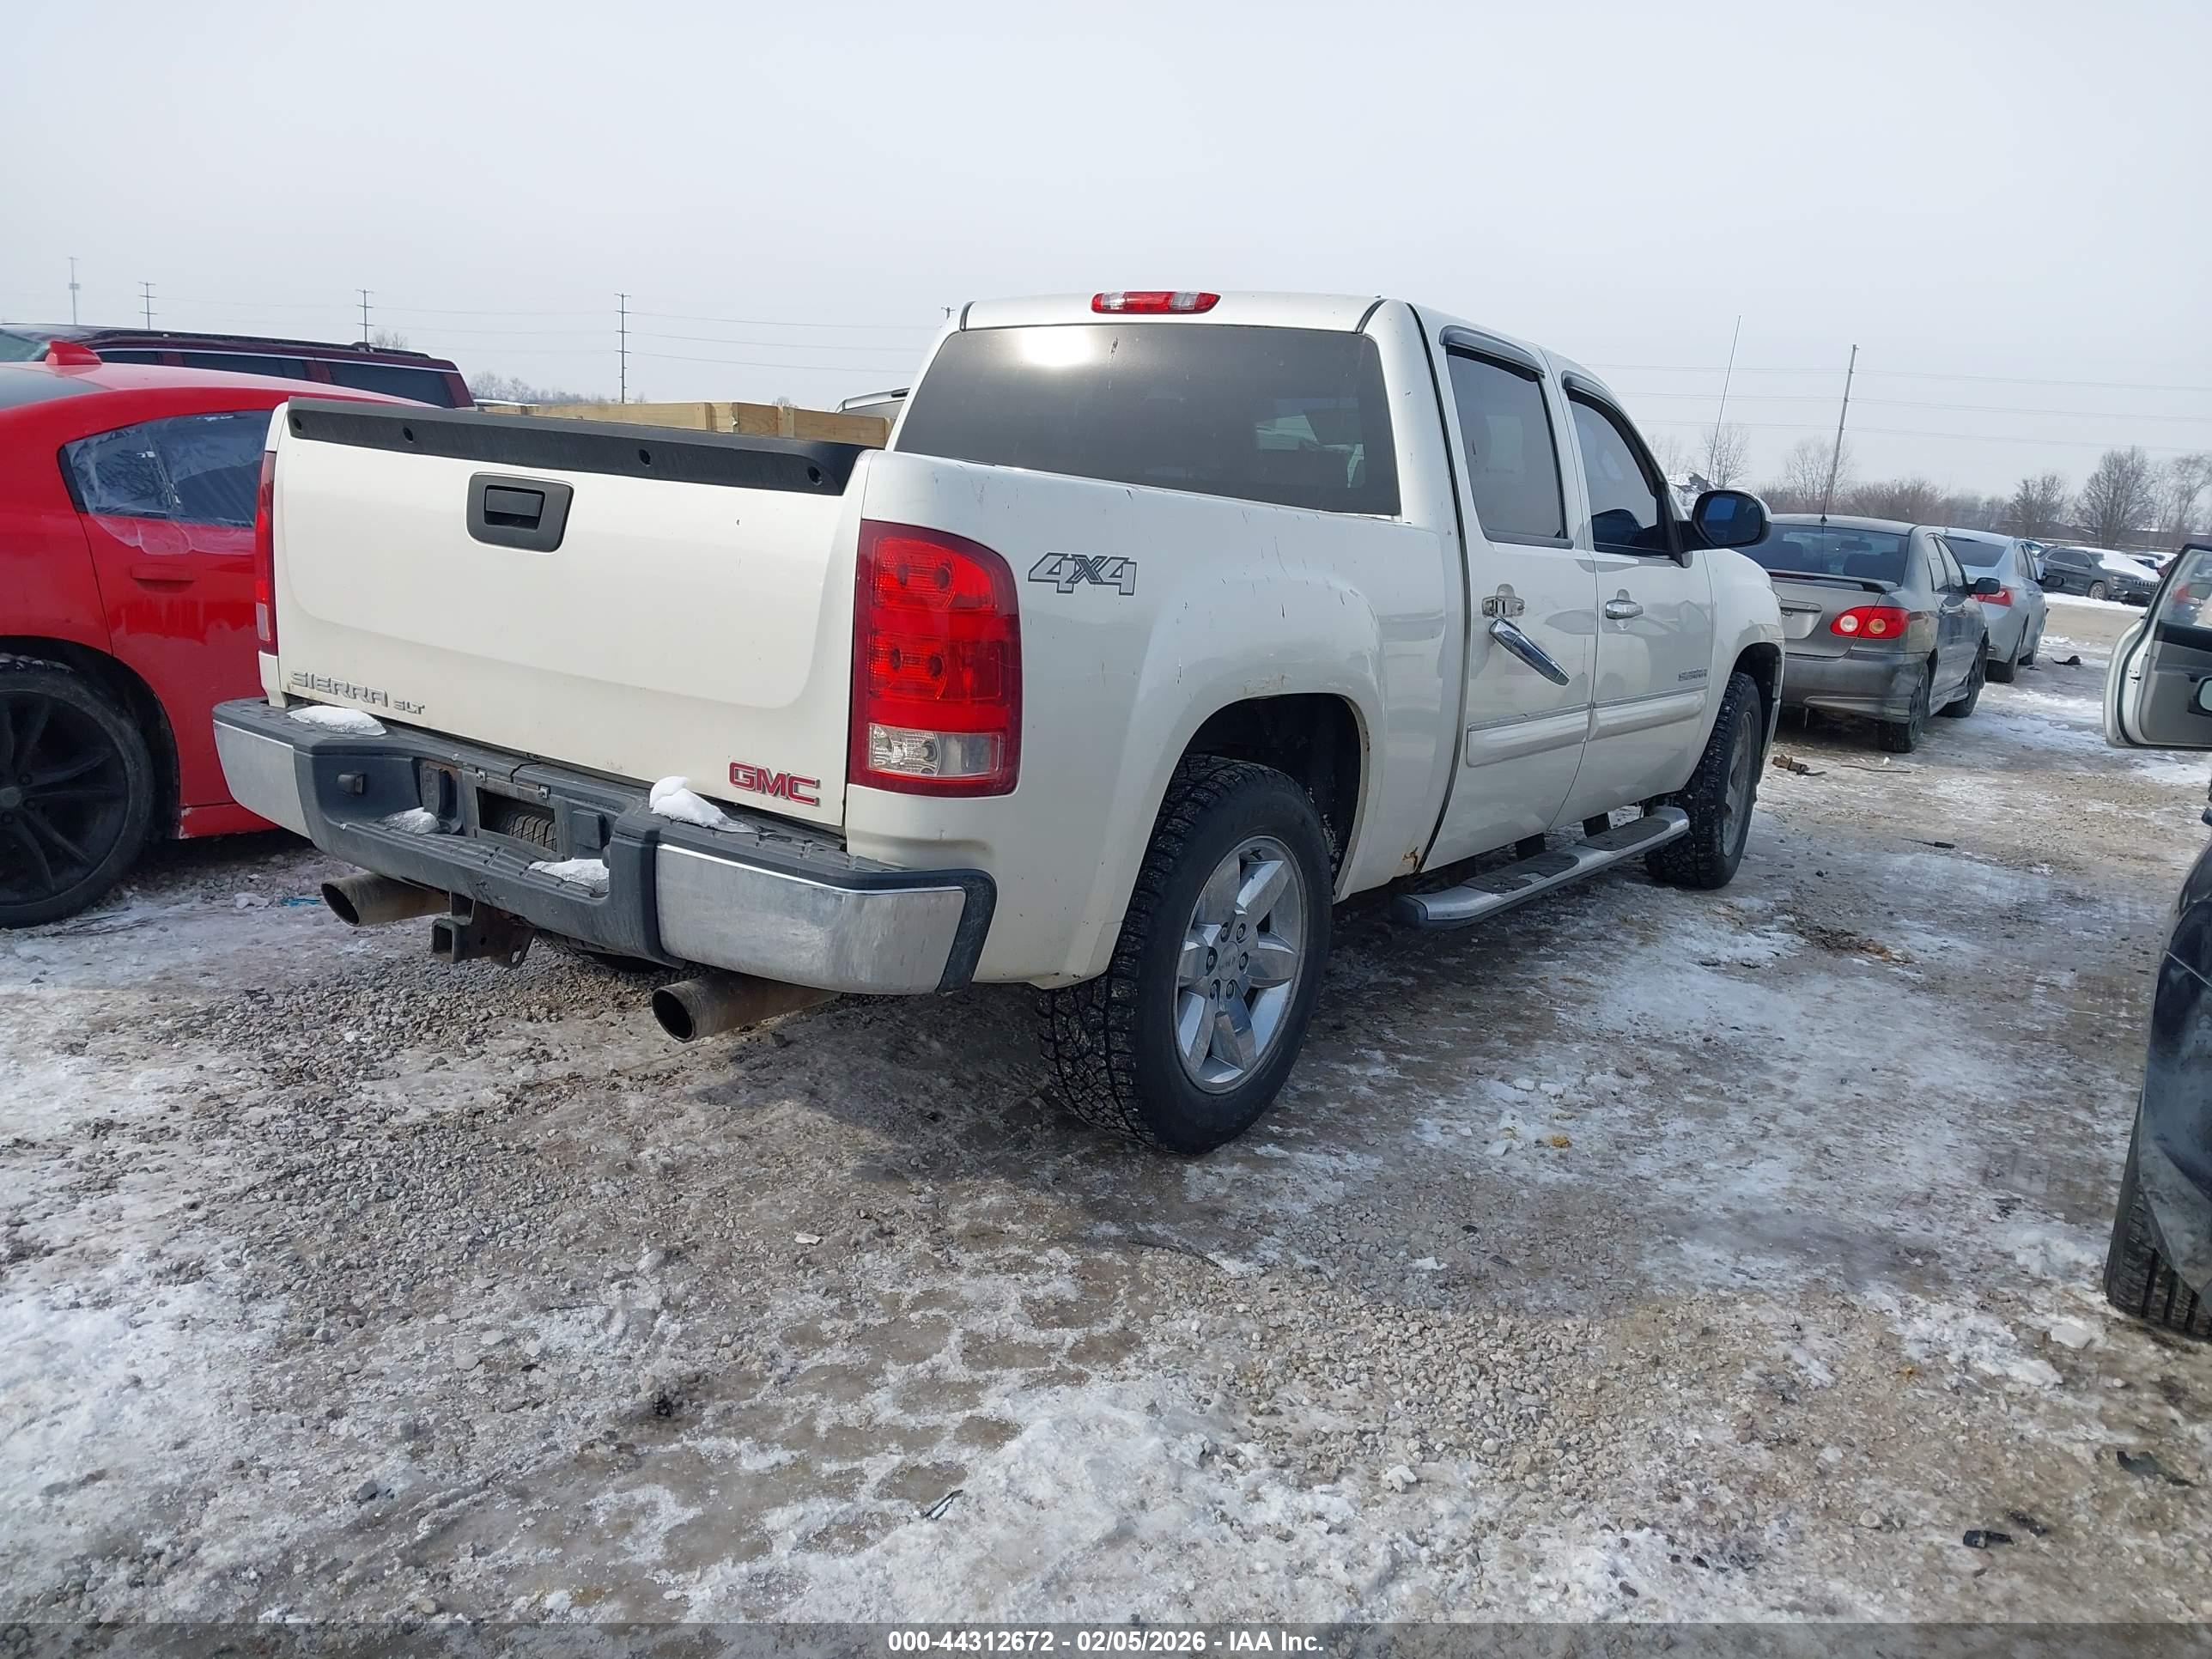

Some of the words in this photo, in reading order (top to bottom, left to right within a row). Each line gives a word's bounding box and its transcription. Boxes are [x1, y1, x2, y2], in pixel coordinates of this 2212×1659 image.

[290, 671, 388, 708] SIERRA
[393, 700, 425, 714] SLT
[728, 761, 820, 806] GMC
